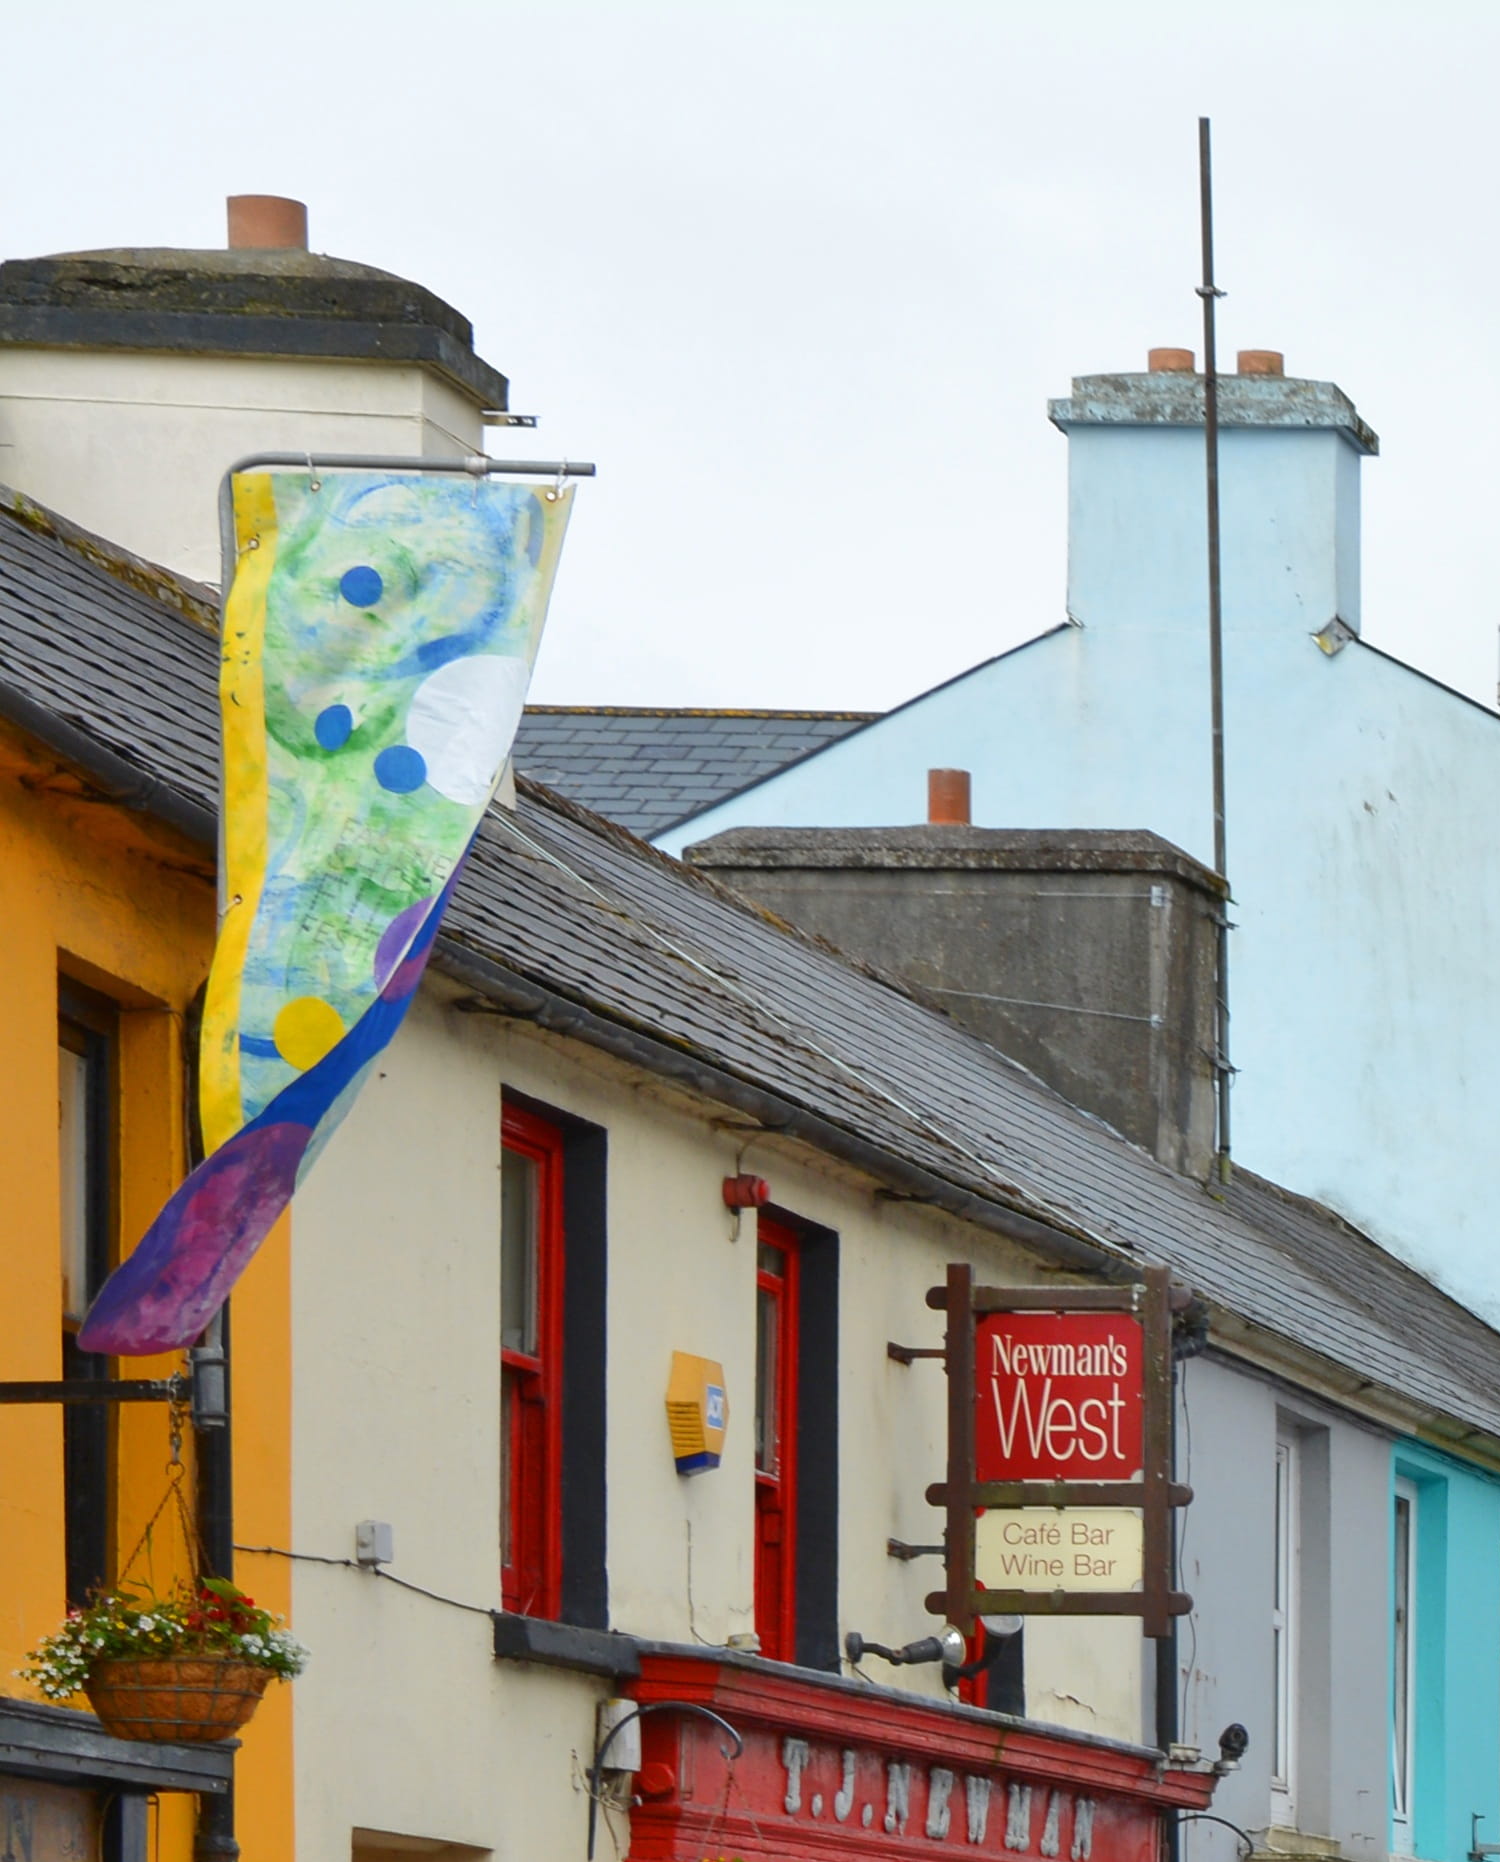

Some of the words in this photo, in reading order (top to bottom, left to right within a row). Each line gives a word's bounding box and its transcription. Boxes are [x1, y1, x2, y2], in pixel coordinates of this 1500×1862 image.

[991, 1334, 1128, 1377] Newman's
[991, 1378, 1127, 1461] West
[1003, 1522, 1061, 1545] Café
[1071, 1523, 1115, 1545] Bar
[1001, 1554, 1064, 1576] Wine
[1074, 1554, 1116, 1576] Bar
